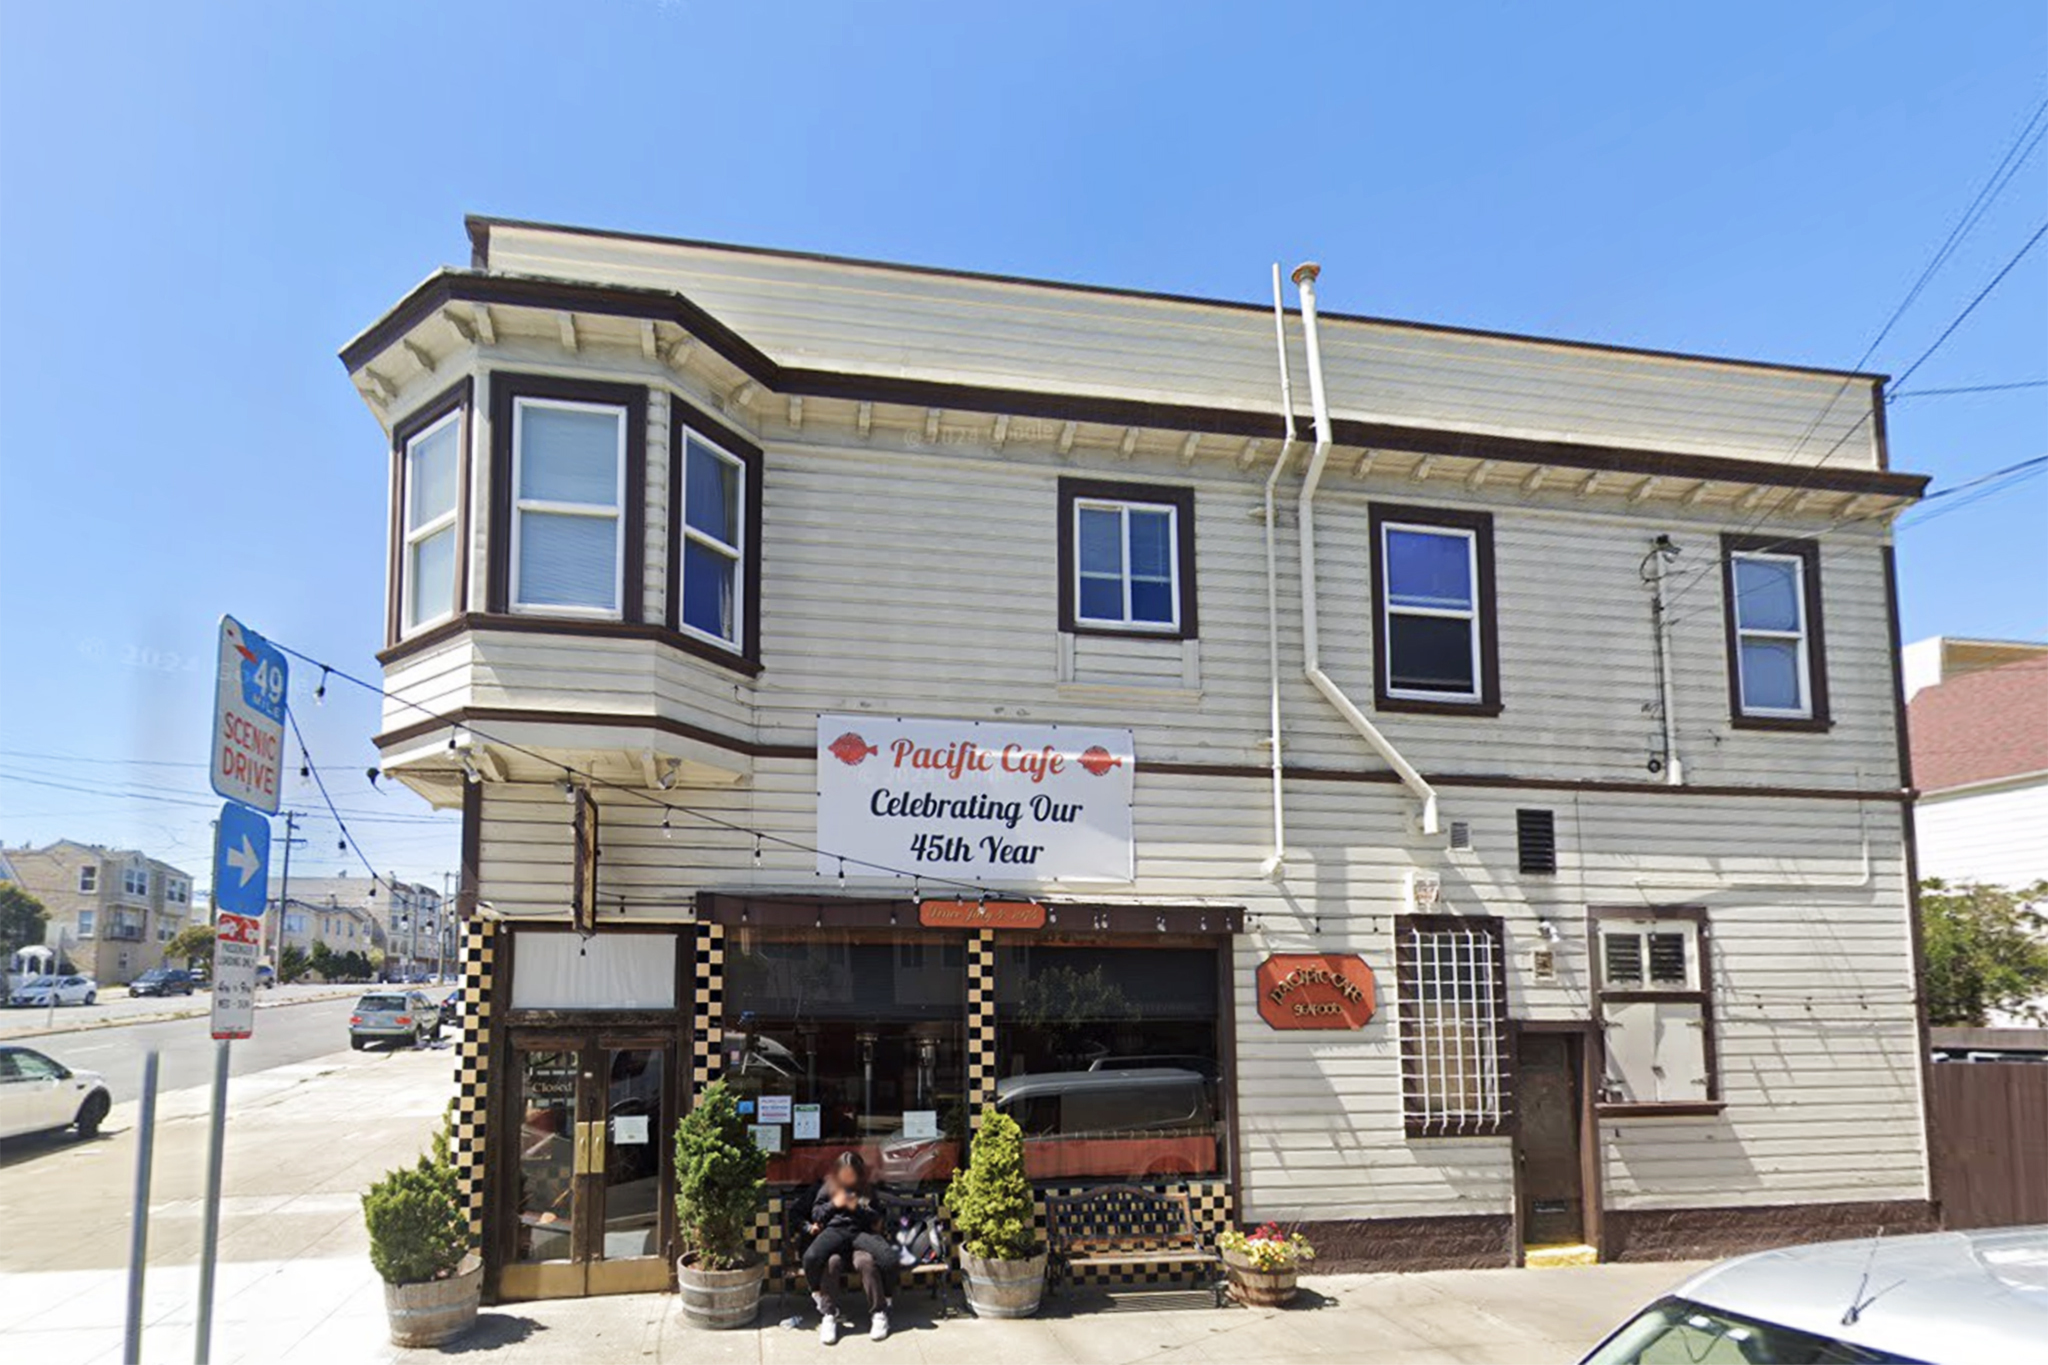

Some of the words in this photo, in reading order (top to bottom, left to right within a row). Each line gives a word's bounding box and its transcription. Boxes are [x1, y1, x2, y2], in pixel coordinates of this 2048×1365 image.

[254, 658, 283, 704] 49
[253, 693, 281, 717] MILE
[224, 711, 277, 761] SCENIC
[222, 745, 274, 795] DRIVE
[890, 737, 994, 781] Pacific
[1000, 742, 1066, 784] Cafe
[870, 787, 1023, 829] Celebrating
[1030, 794, 1083, 823] Our
[910, 833, 974, 863] 45th
[980, 835, 1044, 865] Year
[1293, 1002, 1343, 1016] SEAFOOD
[532, 1081, 573, 1093] Closed
